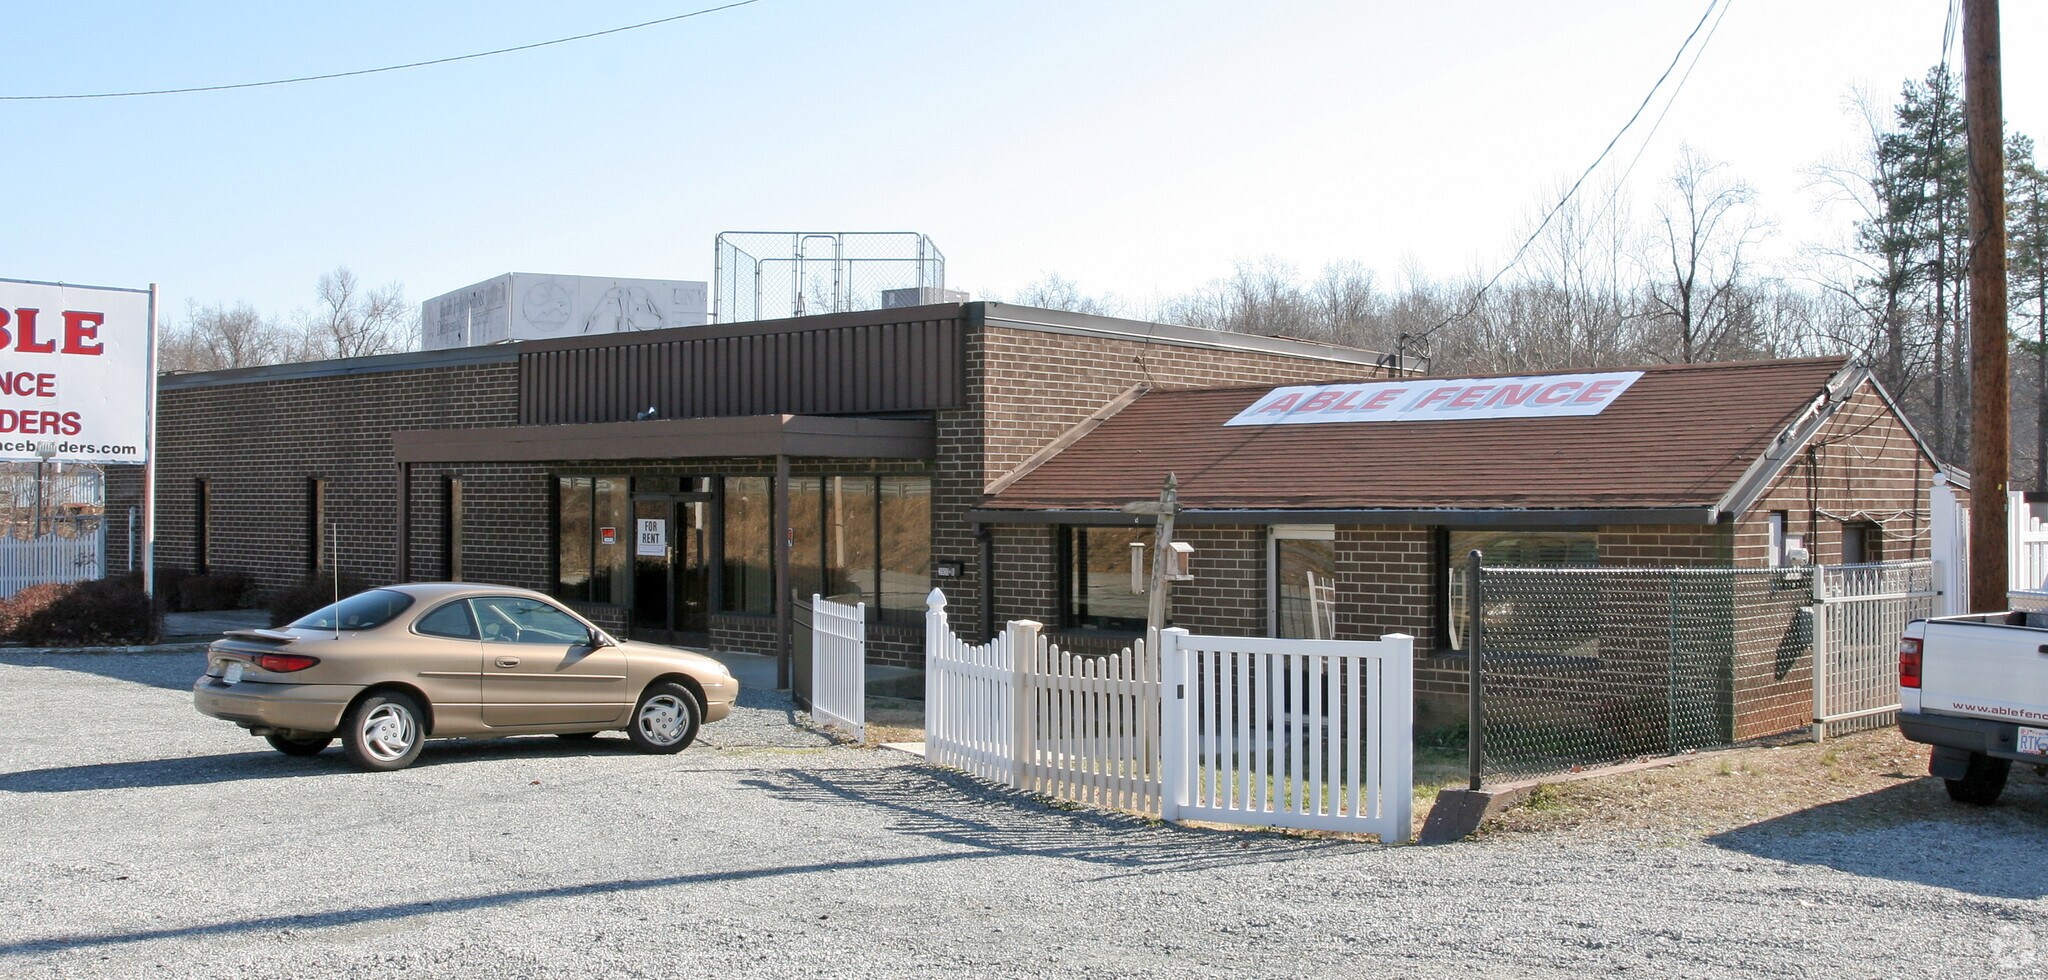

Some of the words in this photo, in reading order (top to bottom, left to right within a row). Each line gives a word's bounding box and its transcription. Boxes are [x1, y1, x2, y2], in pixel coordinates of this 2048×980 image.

[1257, 388, 1409, 414] ABLE
[1412, 380, 1624, 411] FENCE
[0, 409, 82, 435] DERS
[0, 440, 136, 454] cebders.com
[645, 521, 657, 531] FOR
[642, 533, 659, 543] RENT
